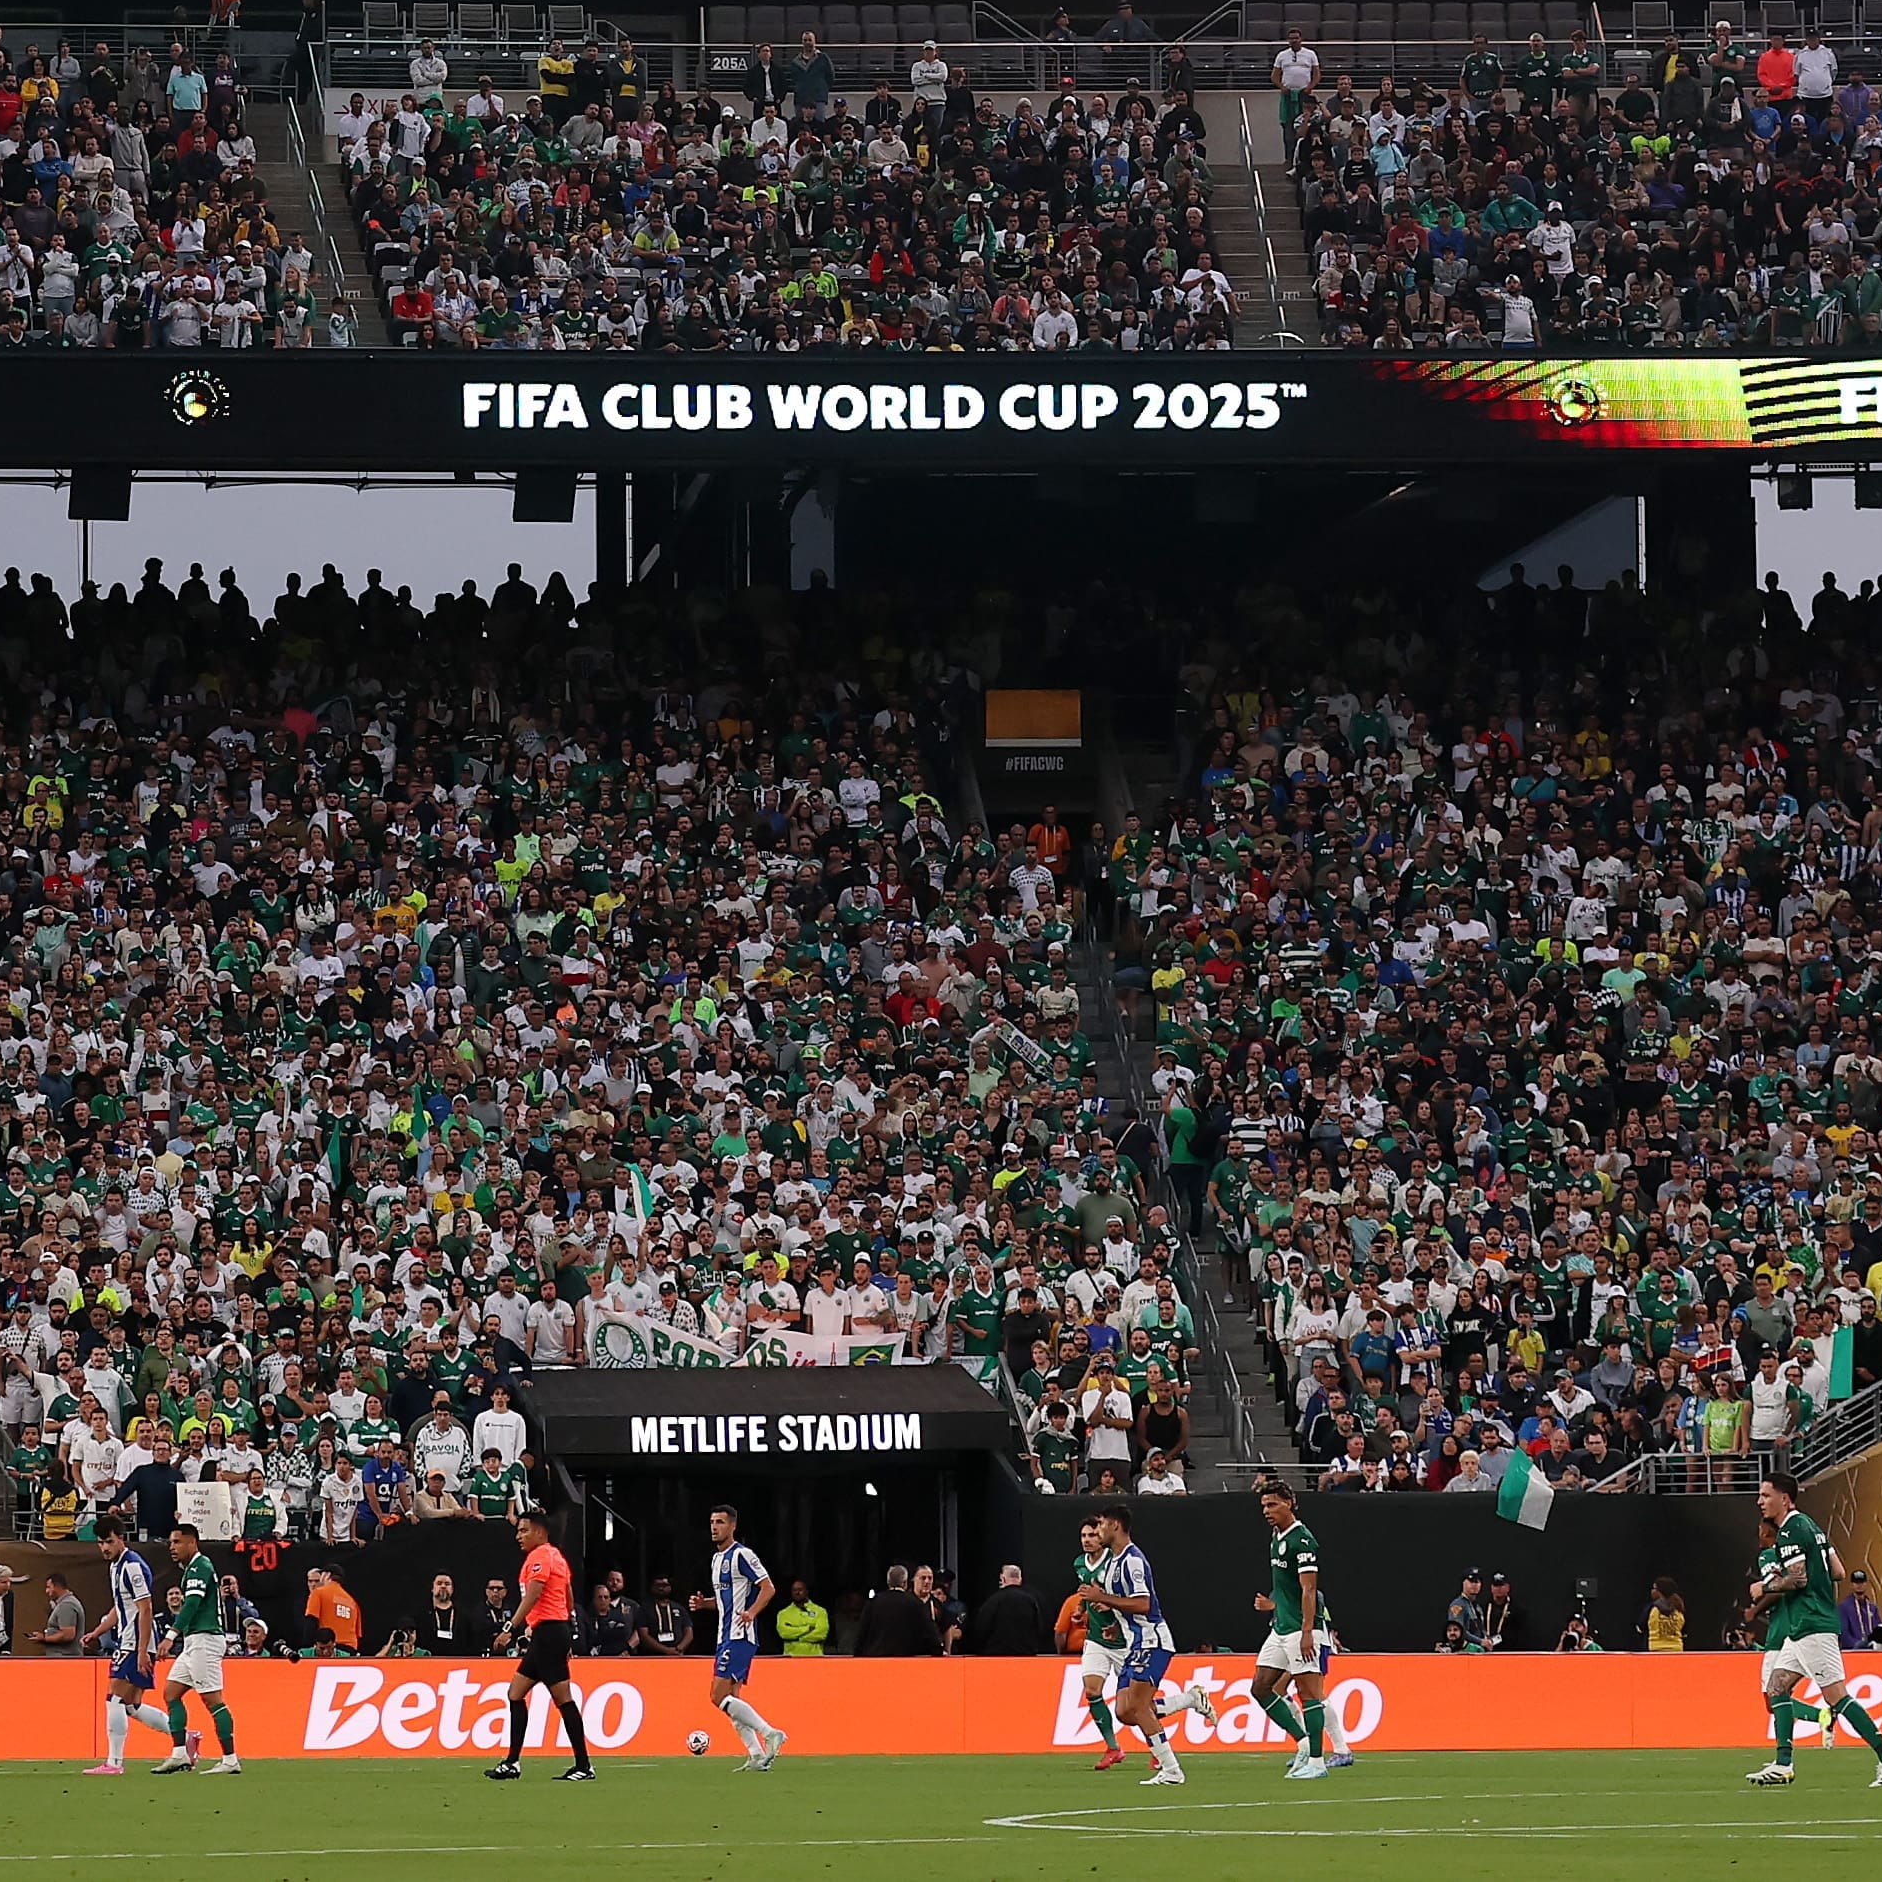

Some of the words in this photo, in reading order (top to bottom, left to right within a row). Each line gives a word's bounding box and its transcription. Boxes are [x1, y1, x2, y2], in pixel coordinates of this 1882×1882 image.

[712, 57, 748, 69] 205A
[463, 382, 589, 429] FIFA
[601, 382, 754, 430] CLUB
[766, 383, 986, 431] WORLD
[998, 382, 1119, 431] CUP
[1005, 755, 1064, 771] #FIFACWC
[630, 1415, 768, 1453] METLIFE
[777, 1413, 921, 1453] STADIUM
[250, 1542, 278, 1572] 20
[302, 1666, 645, 1752] Betano
